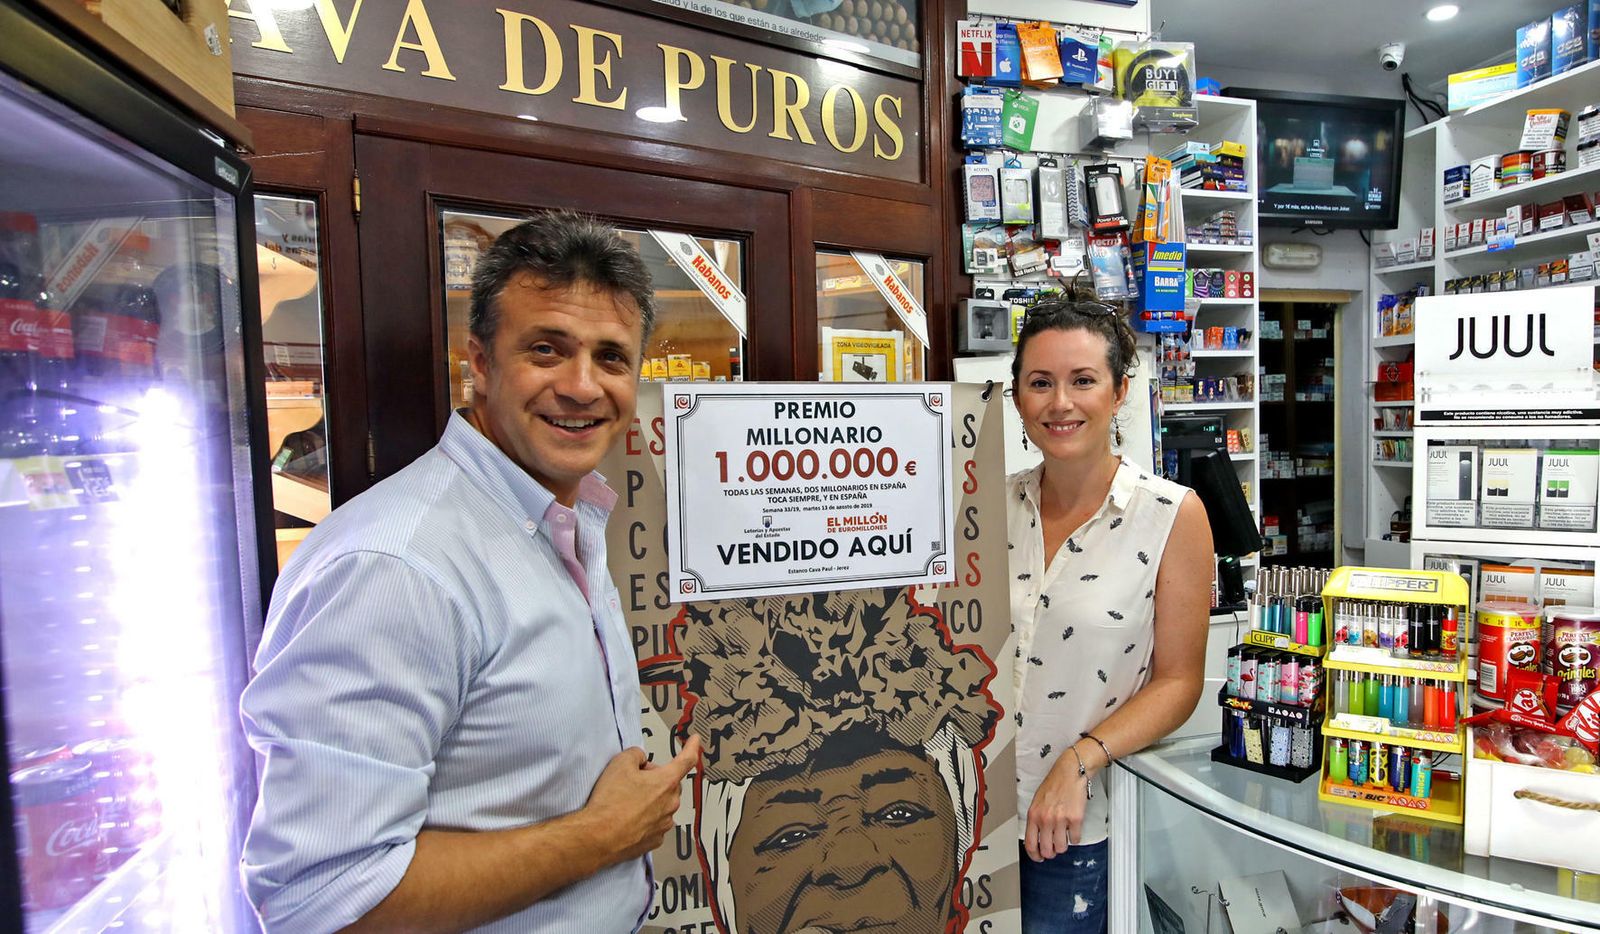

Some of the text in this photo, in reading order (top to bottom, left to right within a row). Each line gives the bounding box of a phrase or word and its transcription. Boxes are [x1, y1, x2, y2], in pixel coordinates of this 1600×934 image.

[683, 1, 689, 9] y
[691, 1, 699, 10] la
[701, 4, 712, 14] de
[714, 7, 727, 18] los
[729, 12, 746, 23] que
[748, 15, 770, 28] están
[771, 22, 777, 30] a
[778, 24, 789, 34] su
[961, 29, 993, 39] NETFLIX
[495, 7, 628, 110] DE
[656, 42, 902, 161] PUROS
[1443, 183, 1461, 192] Fumar
[692, 255, 731, 299] Habanos
[1154, 276, 1179, 287] BARRA
[884, 275, 913, 314] Habanos
[1449, 313, 1555, 360] JUUL
[774, 401, 856, 419] PREMIO
[746, 426, 883, 446] MILLONARIO
[1429, 450, 1448, 459] JUUL
[715, 447, 917, 483] 1.000.000 €
[1487, 457, 1509, 467] JUUL
[1548, 458, 1570, 468] JUUL
[723, 481, 907, 497] TODAS LAS SEMANAS, DOS MILLONARIOS EN ESPAÑA
[767, 496, 788, 504] TOCA
[789, 494, 822, 504] SIEMPRE,
[829, 493, 840, 501] EN
[841, 491, 867, 501] ESPAÑA
[835, 503, 853, 511] agosto
[826, 511, 888, 527] EL MILLÓN
[838, 524, 888, 533] EUROMILLONES
[717, 527, 912, 565] VENDIDO AQUÍ
[1429, 560, 1448, 570] JUUL
[1485, 574, 1506, 584] JUUL
[1545, 577, 1566, 587] JUUL
[1253, 633, 1276, 644] CLIPP
[1557, 665, 1596, 682] Pringles
[1365, 793, 1386, 802] BIC
